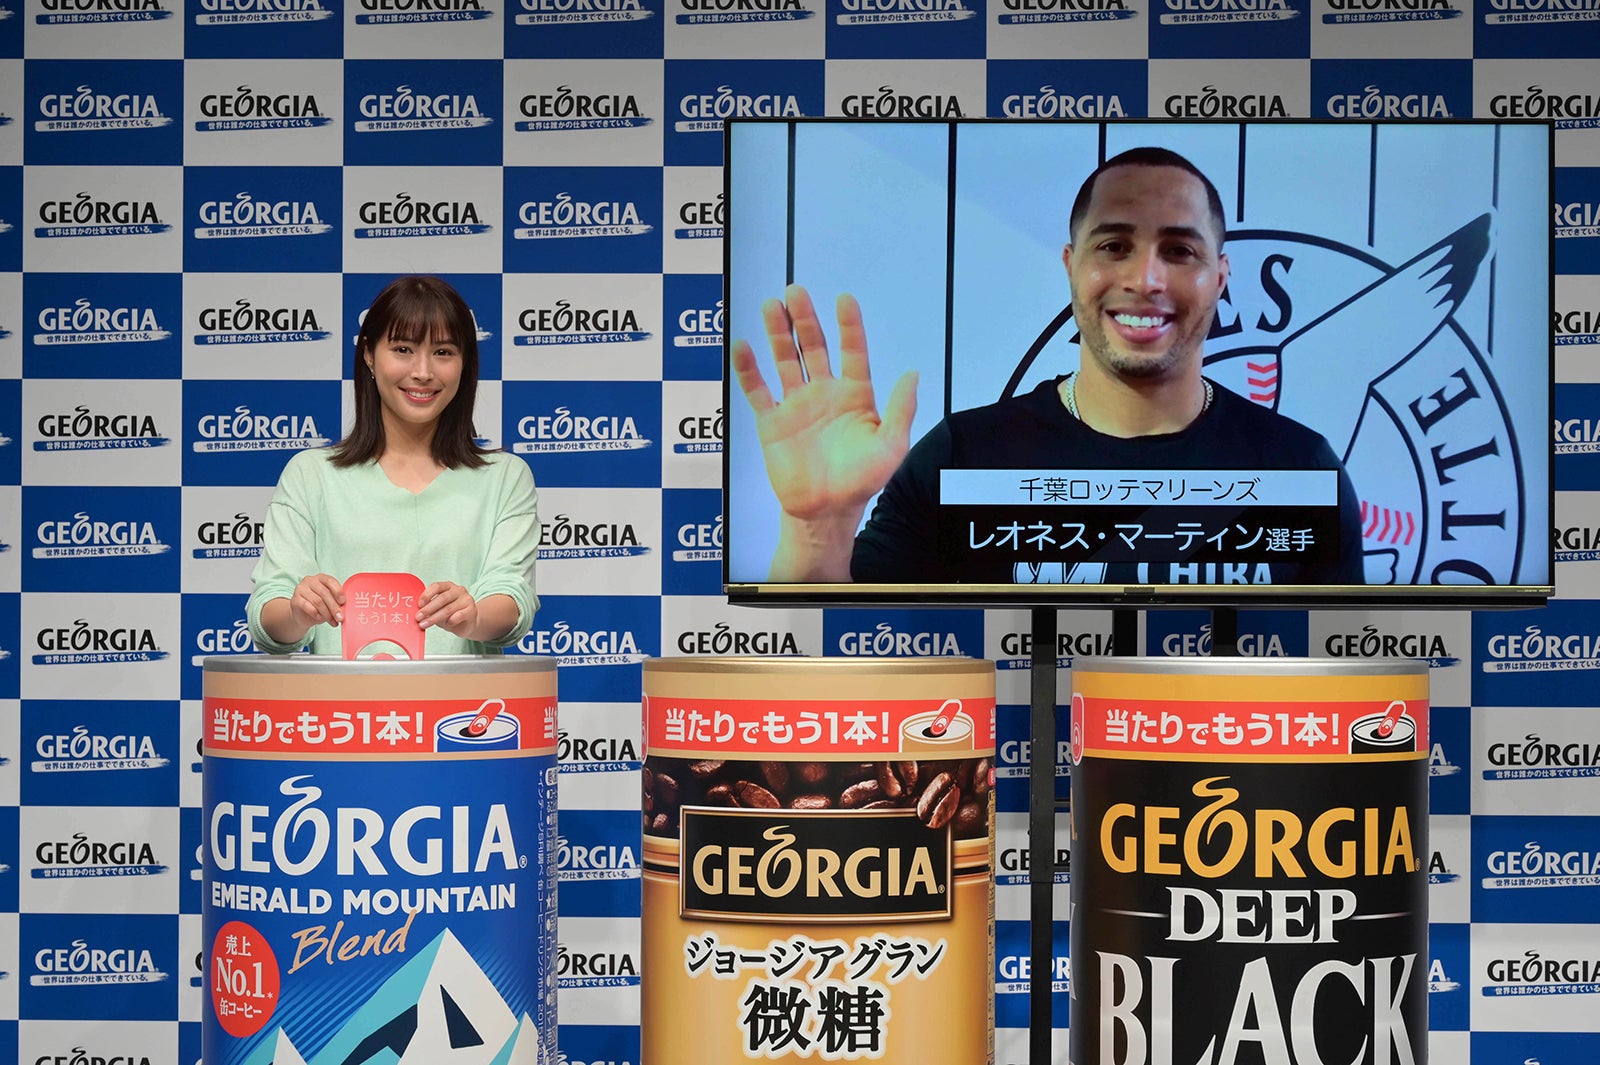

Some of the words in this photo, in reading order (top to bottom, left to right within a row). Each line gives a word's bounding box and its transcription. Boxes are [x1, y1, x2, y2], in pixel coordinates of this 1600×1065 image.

[40, 85, 160, 117] GEORGIA
[199, 85, 319, 117] GEORGIA
[359, 85, 479, 118] GEORGIA
[520, 85, 640, 118] GEORGIA
[680, 85, 800, 118] GEORGIA
[842, 85, 962, 118] GEORGIA
[1003, 85, 1123, 118] GEORGIA
[1165, 85, 1285, 118] GEORGIA
[1328, 85, 1448, 118] GEORGIA
[39, 192, 159, 224] GEORGIA
[199, 192, 319, 224] GEORGIA
[359, 192, 479, 225] GEORGIA
[519, 192, 639, 225] GEORGIA
[39, 298, 159, 331] GEORGIA
[198, 299, 318, 331] GEORGIA
[519, 299, 639, 332] GEORGIA
[38, 405, 158, 438] GEORGIA
[198, 406, 318, 438] GEORGIA
[518, 407, 638, 439] GEORGIA
[1019, 477, 1261, 501] 千葉ロッテマリーンズ
[37, 512, 157, 545] GEORGIA
[539, 514, 637, 547] EORGIA
[969, 520, 1315, 552] レオネス・マーティン選手
[37, 619, 157, 651] GEORGIA
[678, 622, 798, 655] GEORGIA
[839, 623, 959, 655] GEORGIA
[1326, 625, 1446, 658] GEORGIA
[36, 726, 156, 758] GEORGIA
[213, 708, 423, 745] 当たりでもう1本!
[665, 708, 889, 746] 当たりでもう1本!
[1105, 710, 1339, 747] 当たりでもう1本!
[35, 833, 155, 865] GEORGIA
[211, 881, 331, 915] EMERALD
[343, 884, 516, 915] MOUNTAIN
[1165, 886, 1358, 943] DEEP
[35, 940, 155, 973] GEORGIA
[225, 935, 251, 957] 売上
[288, 909, 417, 974] Blend
[219, 998, 263, 1019] 缶コーヒー
[743, 984, 885, 1054] 微糖
[1095, 950, 1418, 1065] BLACK
